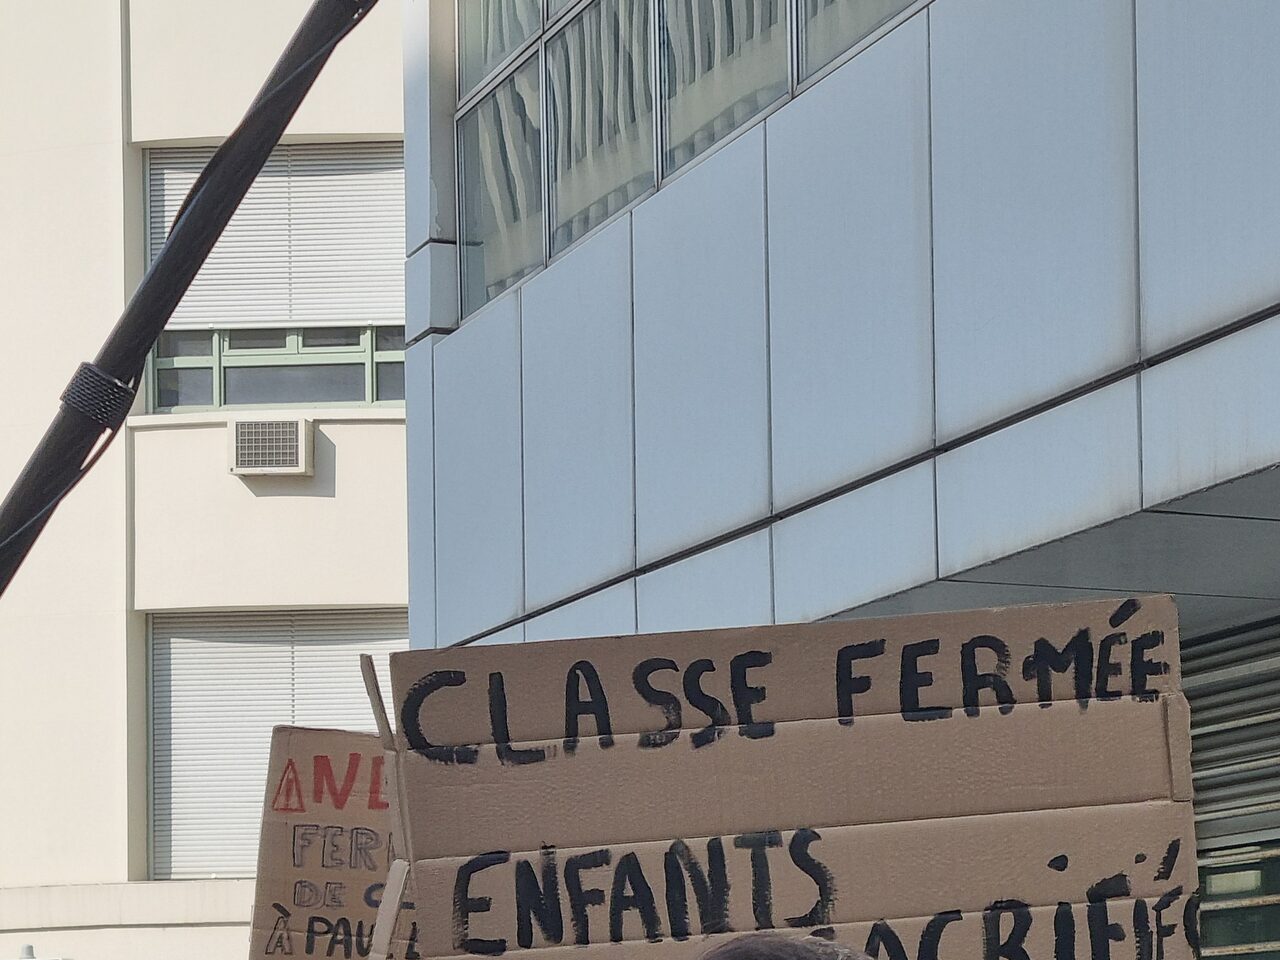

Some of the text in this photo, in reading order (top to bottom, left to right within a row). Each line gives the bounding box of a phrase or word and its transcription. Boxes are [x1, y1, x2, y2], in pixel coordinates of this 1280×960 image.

[401, 598, 1171, 767] CLASSE FERMÉE
[265, 902, 293, 955] À
[293, 880, 345, 910] DE
[453, 828, 836, 956] ENFANTS
